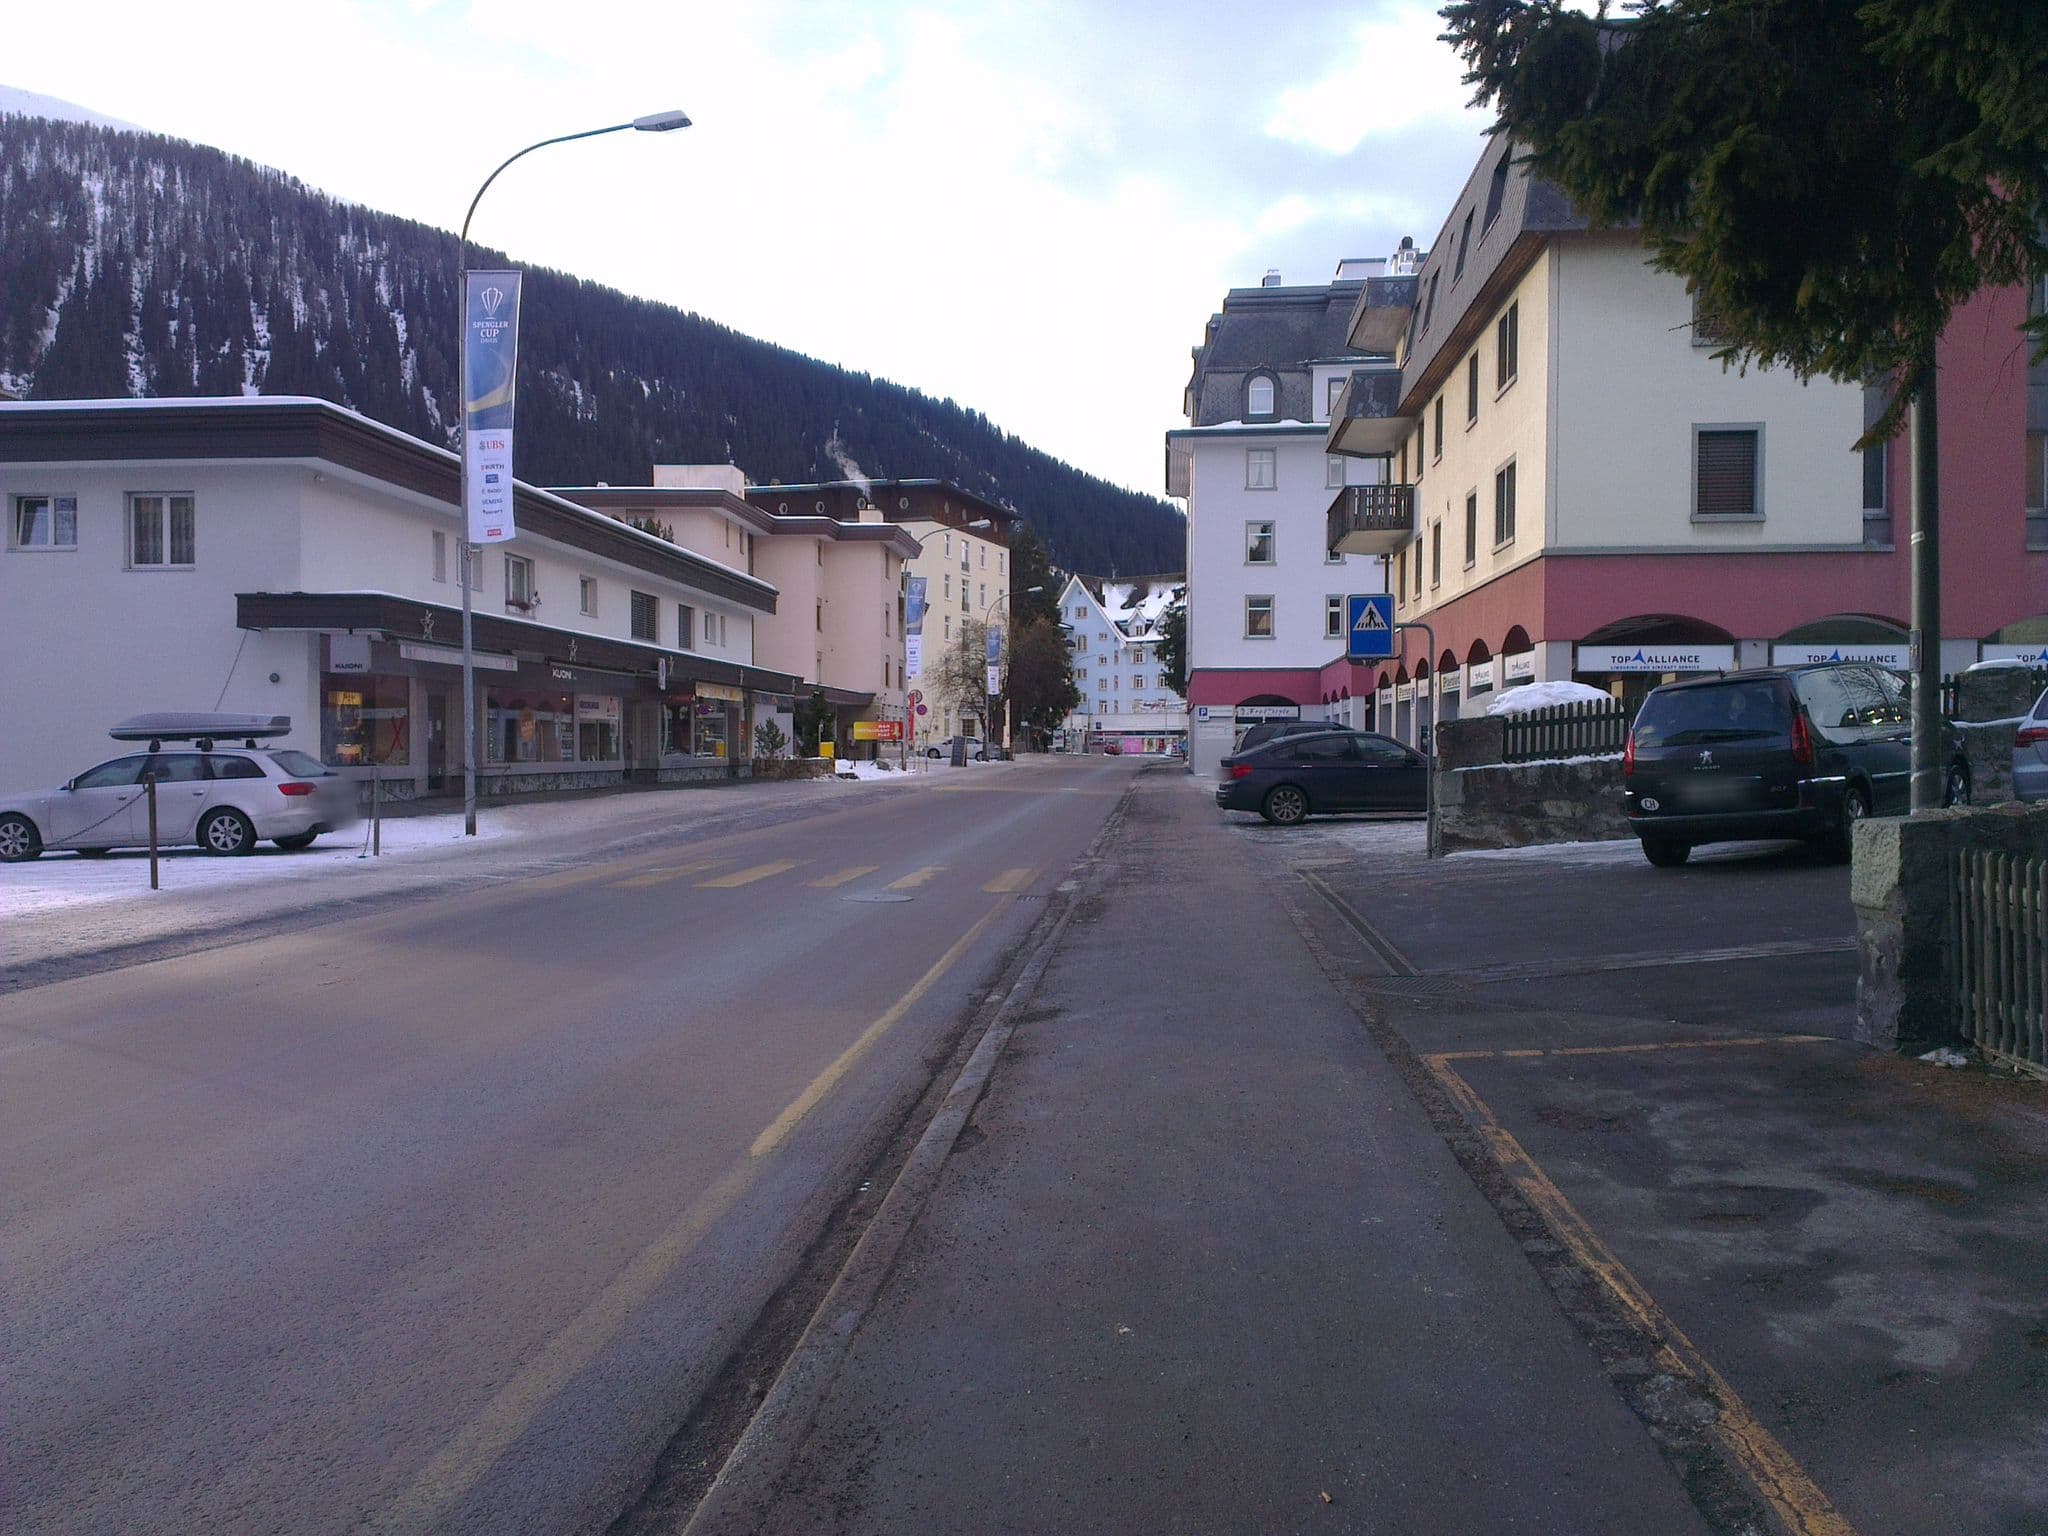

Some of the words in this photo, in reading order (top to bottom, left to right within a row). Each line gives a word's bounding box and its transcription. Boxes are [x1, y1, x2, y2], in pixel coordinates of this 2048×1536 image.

[472, 321, 509, 329] SPENGLER
[480, 329, 500, 338] CUP
[486, 440, 505, 450] UBS
[1611, 655, 1631, 664] TOP
[1647, 655, 1700, 663] ALLIANCE
[1807, 654, 1828, 663] TOP
[1844, 654, 1897, 663] ALLIANCE
[2015, 654, 2037, 663] TOP
[1644, 799, 1656, 809] CH
